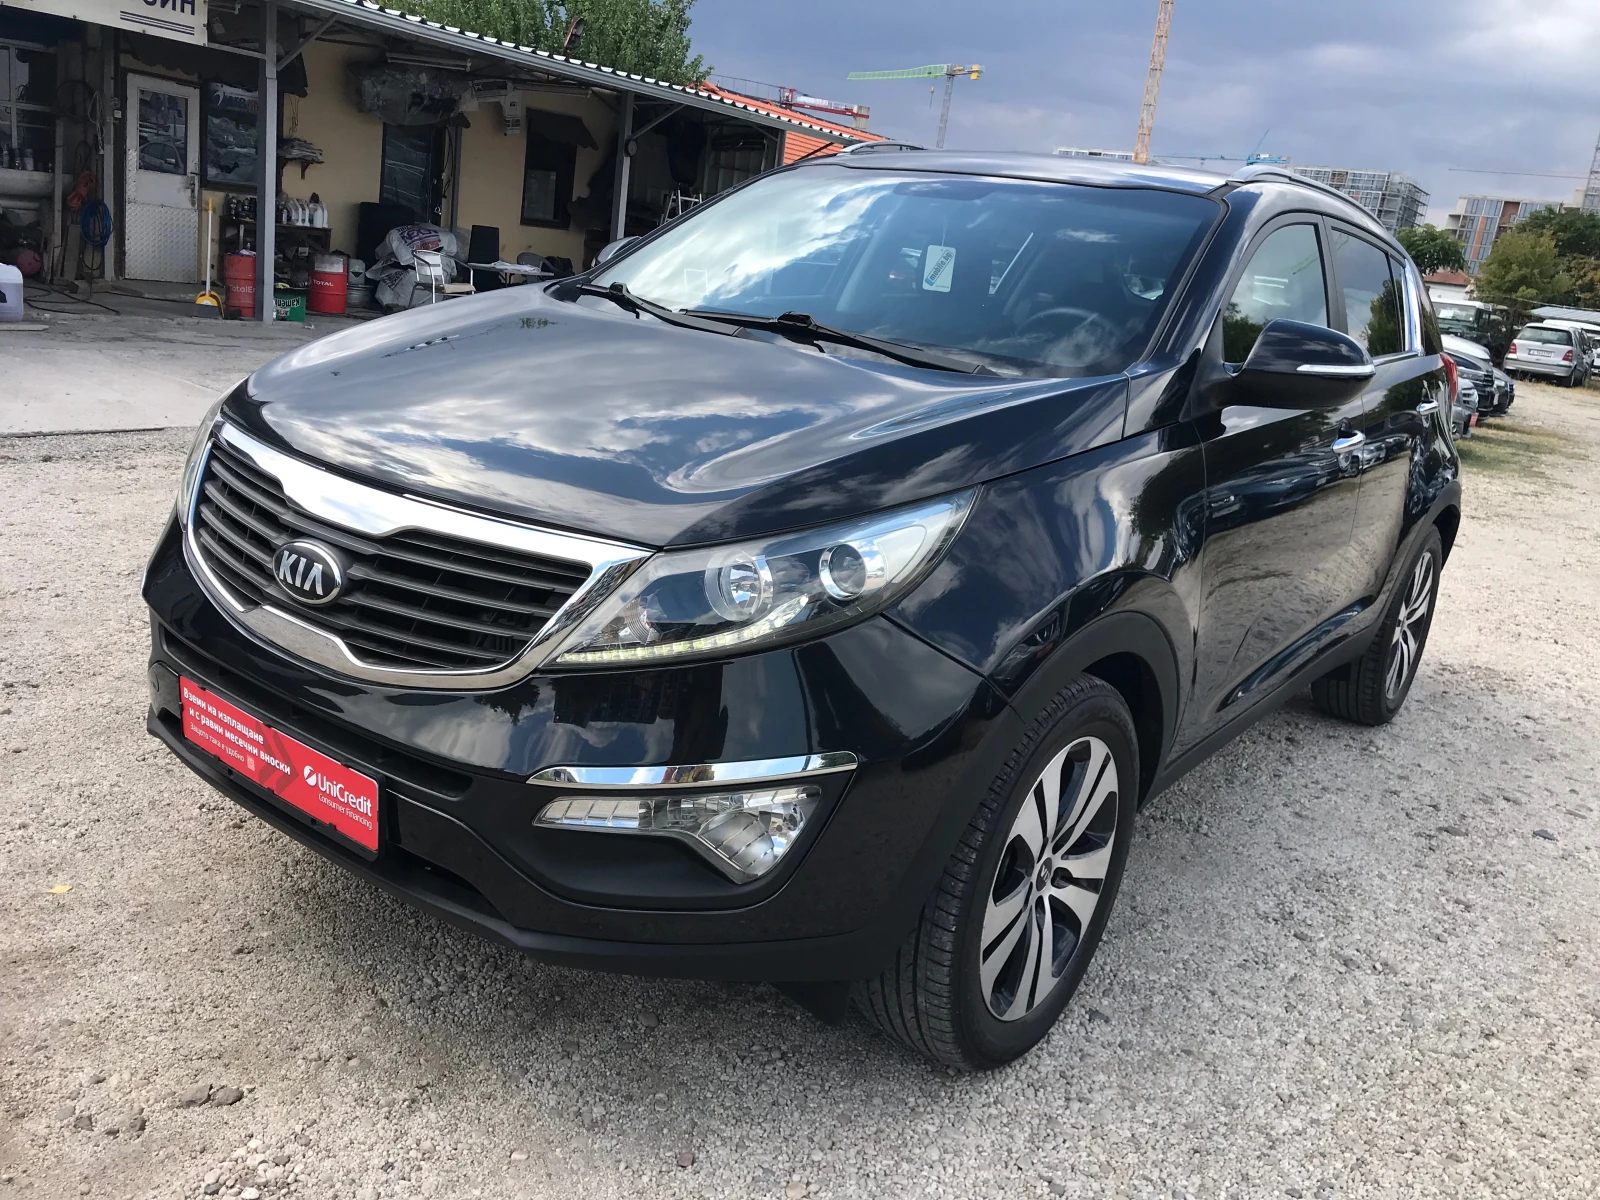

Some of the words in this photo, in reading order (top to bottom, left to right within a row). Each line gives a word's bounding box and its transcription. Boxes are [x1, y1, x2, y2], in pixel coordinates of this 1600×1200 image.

[313, 279, 334, 287] TOTAL
[929, 252, 953, 281] mobile.bg
[275, 297, 301, 308] Kameni
[279, 550, 324, 596] KIA
[183, 687, 207, 710] Вземи
[207, 703, 217, 717] на
[218, 710, 264, 745] изплащане
[189, 706, 195, 716] и
[195, 711, 200, 721] с
[201, 714, 224, 735] равни
[225, 729, 259, 757] месечни
[260, 750, 291, 776] вноски
[318, 773, 372, 817] UniCredit
[318, 793, 345, 814] Consumer
[346, 807, 373, 831] Financing
